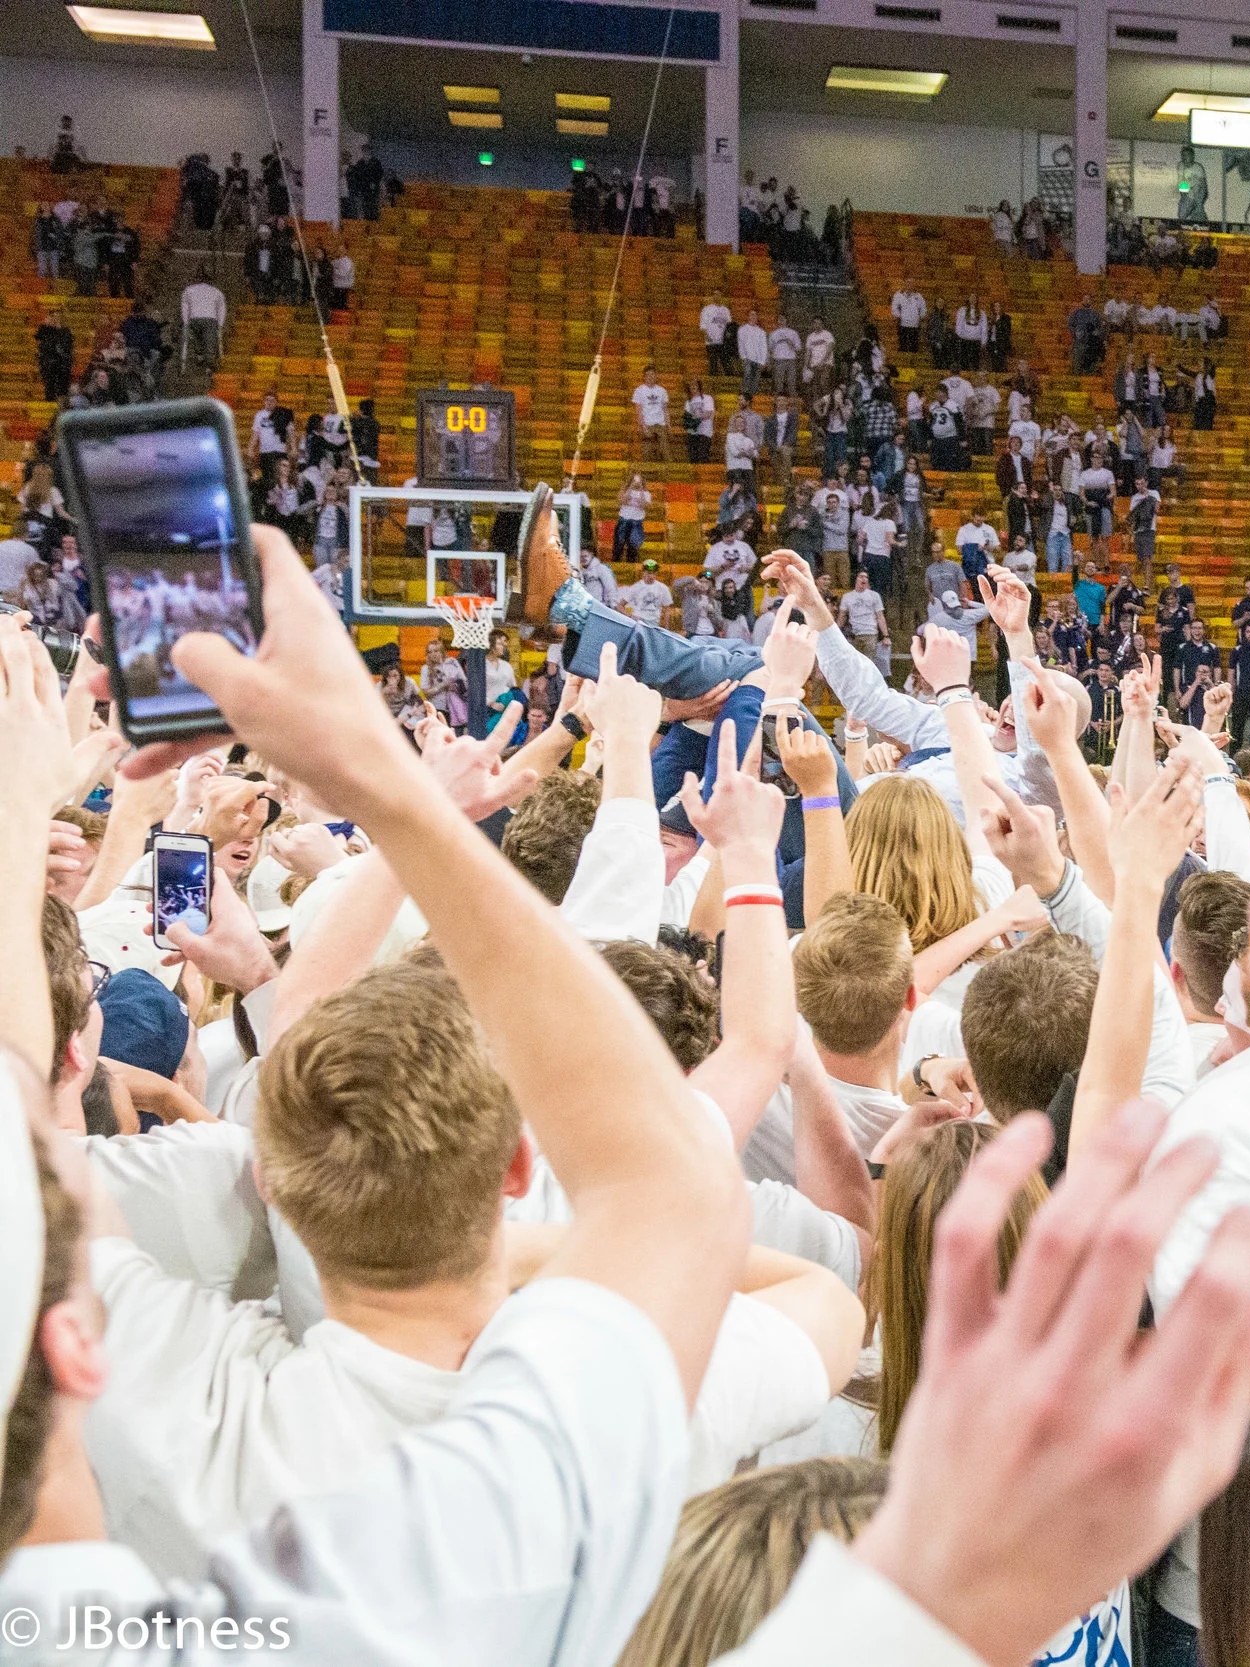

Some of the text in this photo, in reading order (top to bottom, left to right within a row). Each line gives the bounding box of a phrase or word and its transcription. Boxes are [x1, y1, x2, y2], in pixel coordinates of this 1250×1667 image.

[313, 108, 328, 125] F
[715, 137, 729, 153] F
[1084, 160, 1099, 177] G
